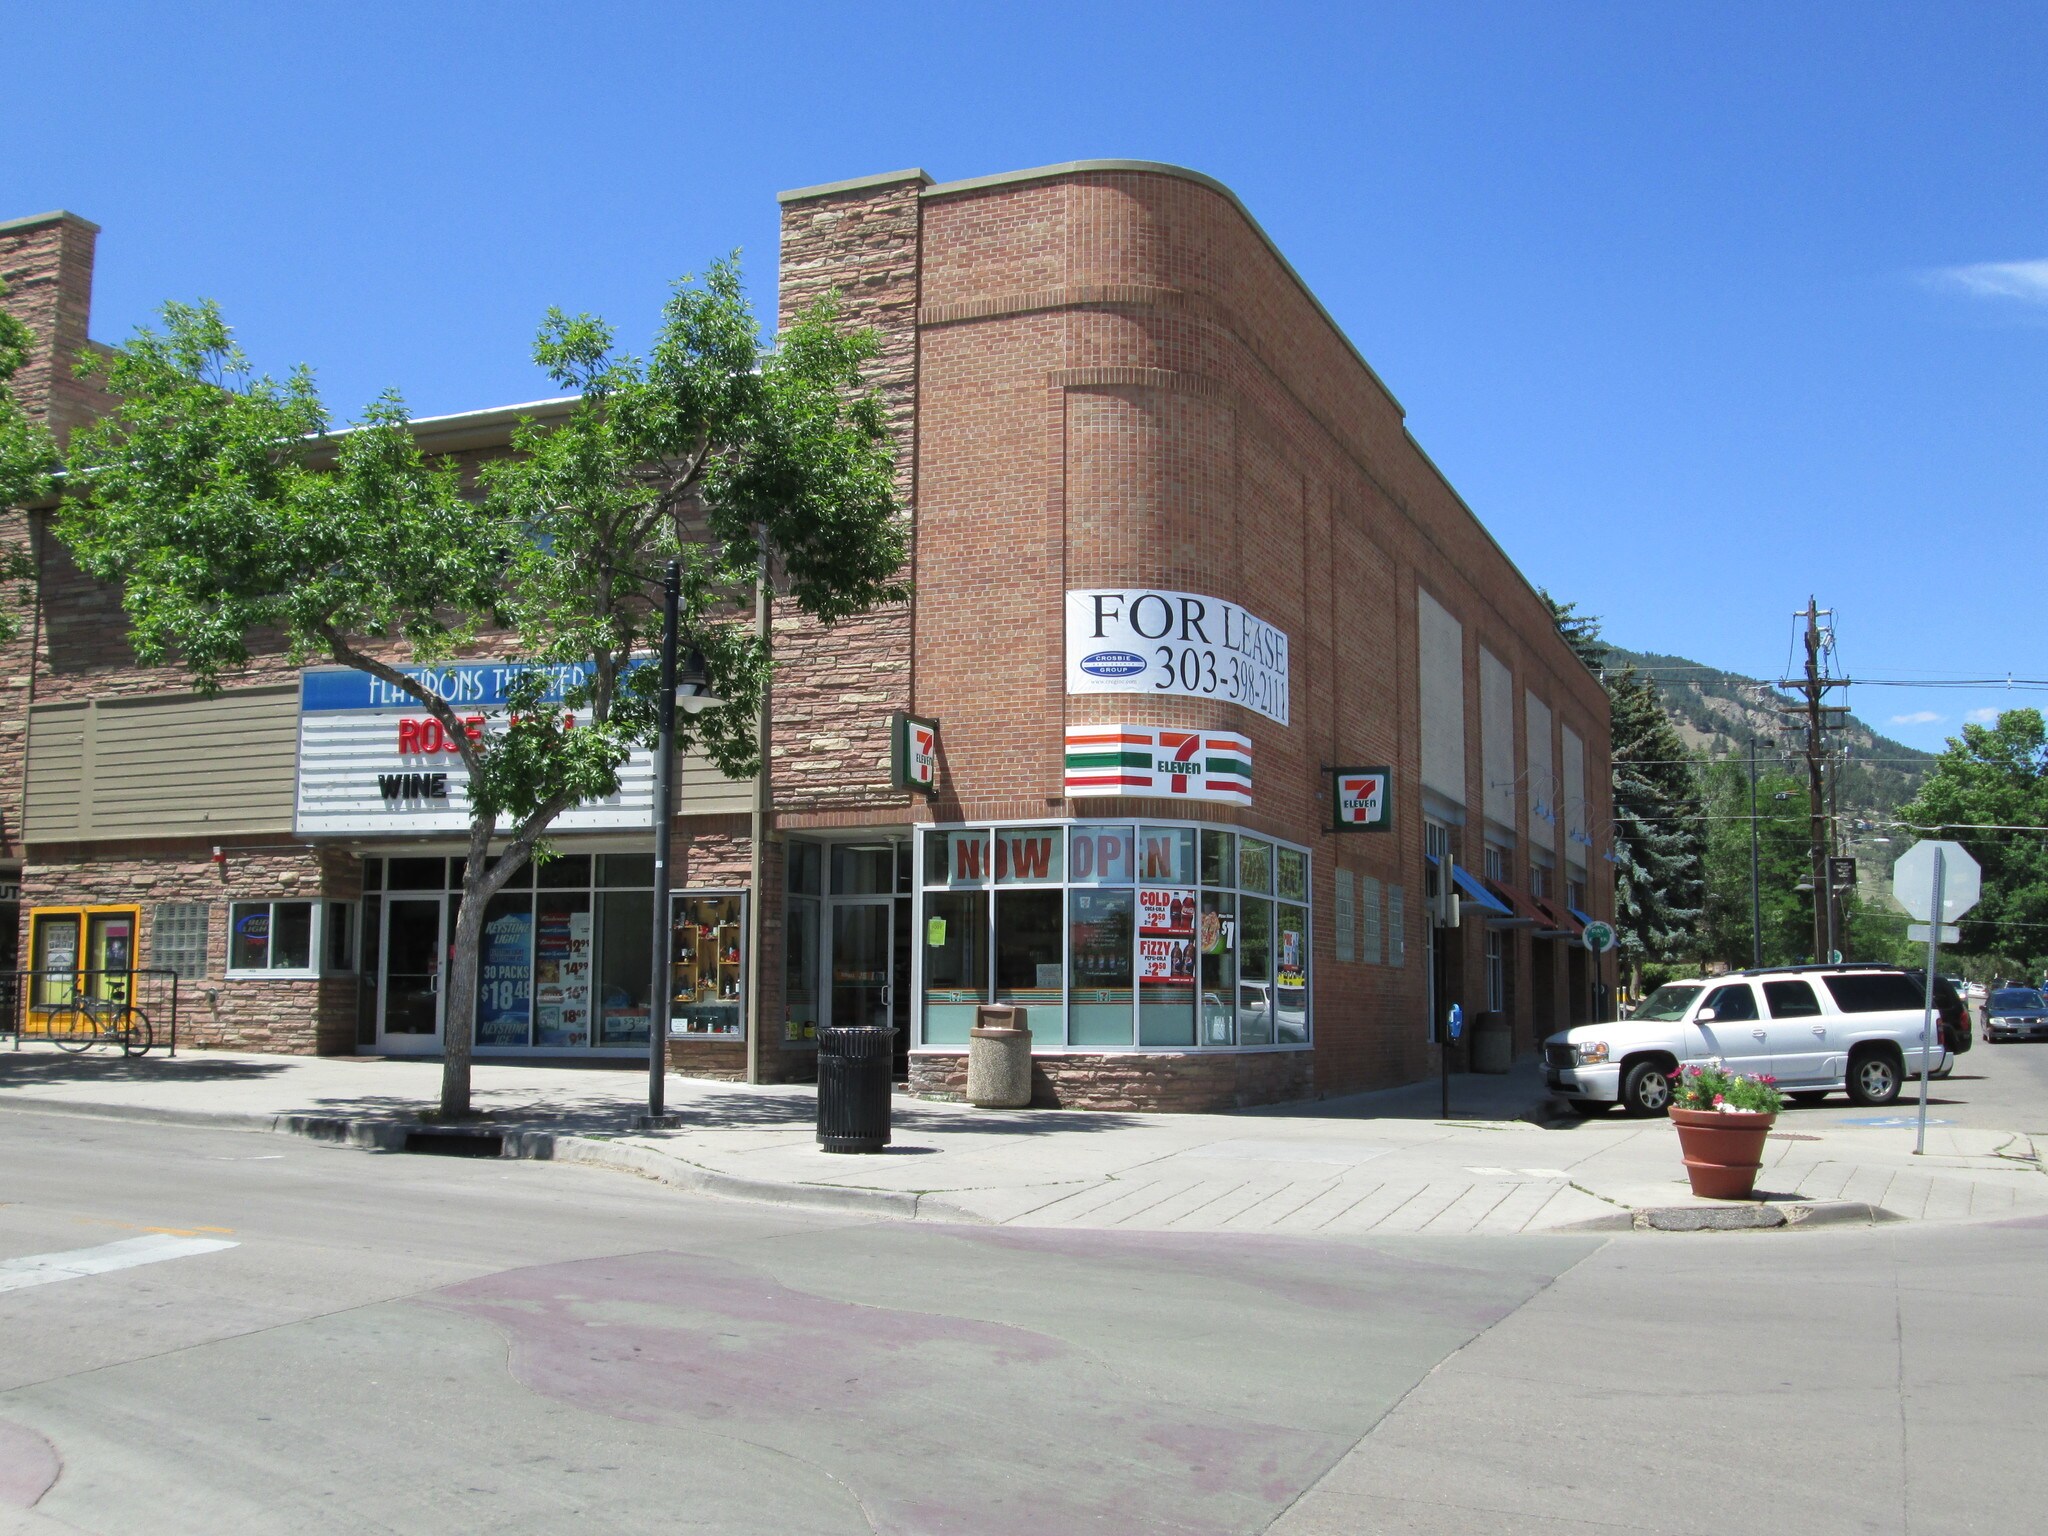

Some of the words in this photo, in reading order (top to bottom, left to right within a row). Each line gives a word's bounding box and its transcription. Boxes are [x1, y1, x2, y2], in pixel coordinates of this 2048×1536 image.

[1089, 594, 1212, 644] FOR
[1221, 605, 1286, 675] LEASE
[1155, 646, 1286, 720] 303-398-2111
[1159, 732, 1200, 793] 7
[378, 773, 447, 799] WINE
[1345, 780, 1376, 821] 7
[956, 837, 1052, 880] NOW
[1072, 835, 1171, 878] OPEN
[1140, 891, 1170, 907] COLD
[485, 922, 530, 934] KEYSTONE
[495, 934, 520, 945] LIGHT
[1221, 920, 1235, 949] $1
[1140, 940, 1172, 956] FiZZY
[483, 965, 496, 979] 30
[498, 965, 530, 979] PACKS
[482, 1022, 528, 1034] KEYSTONE
